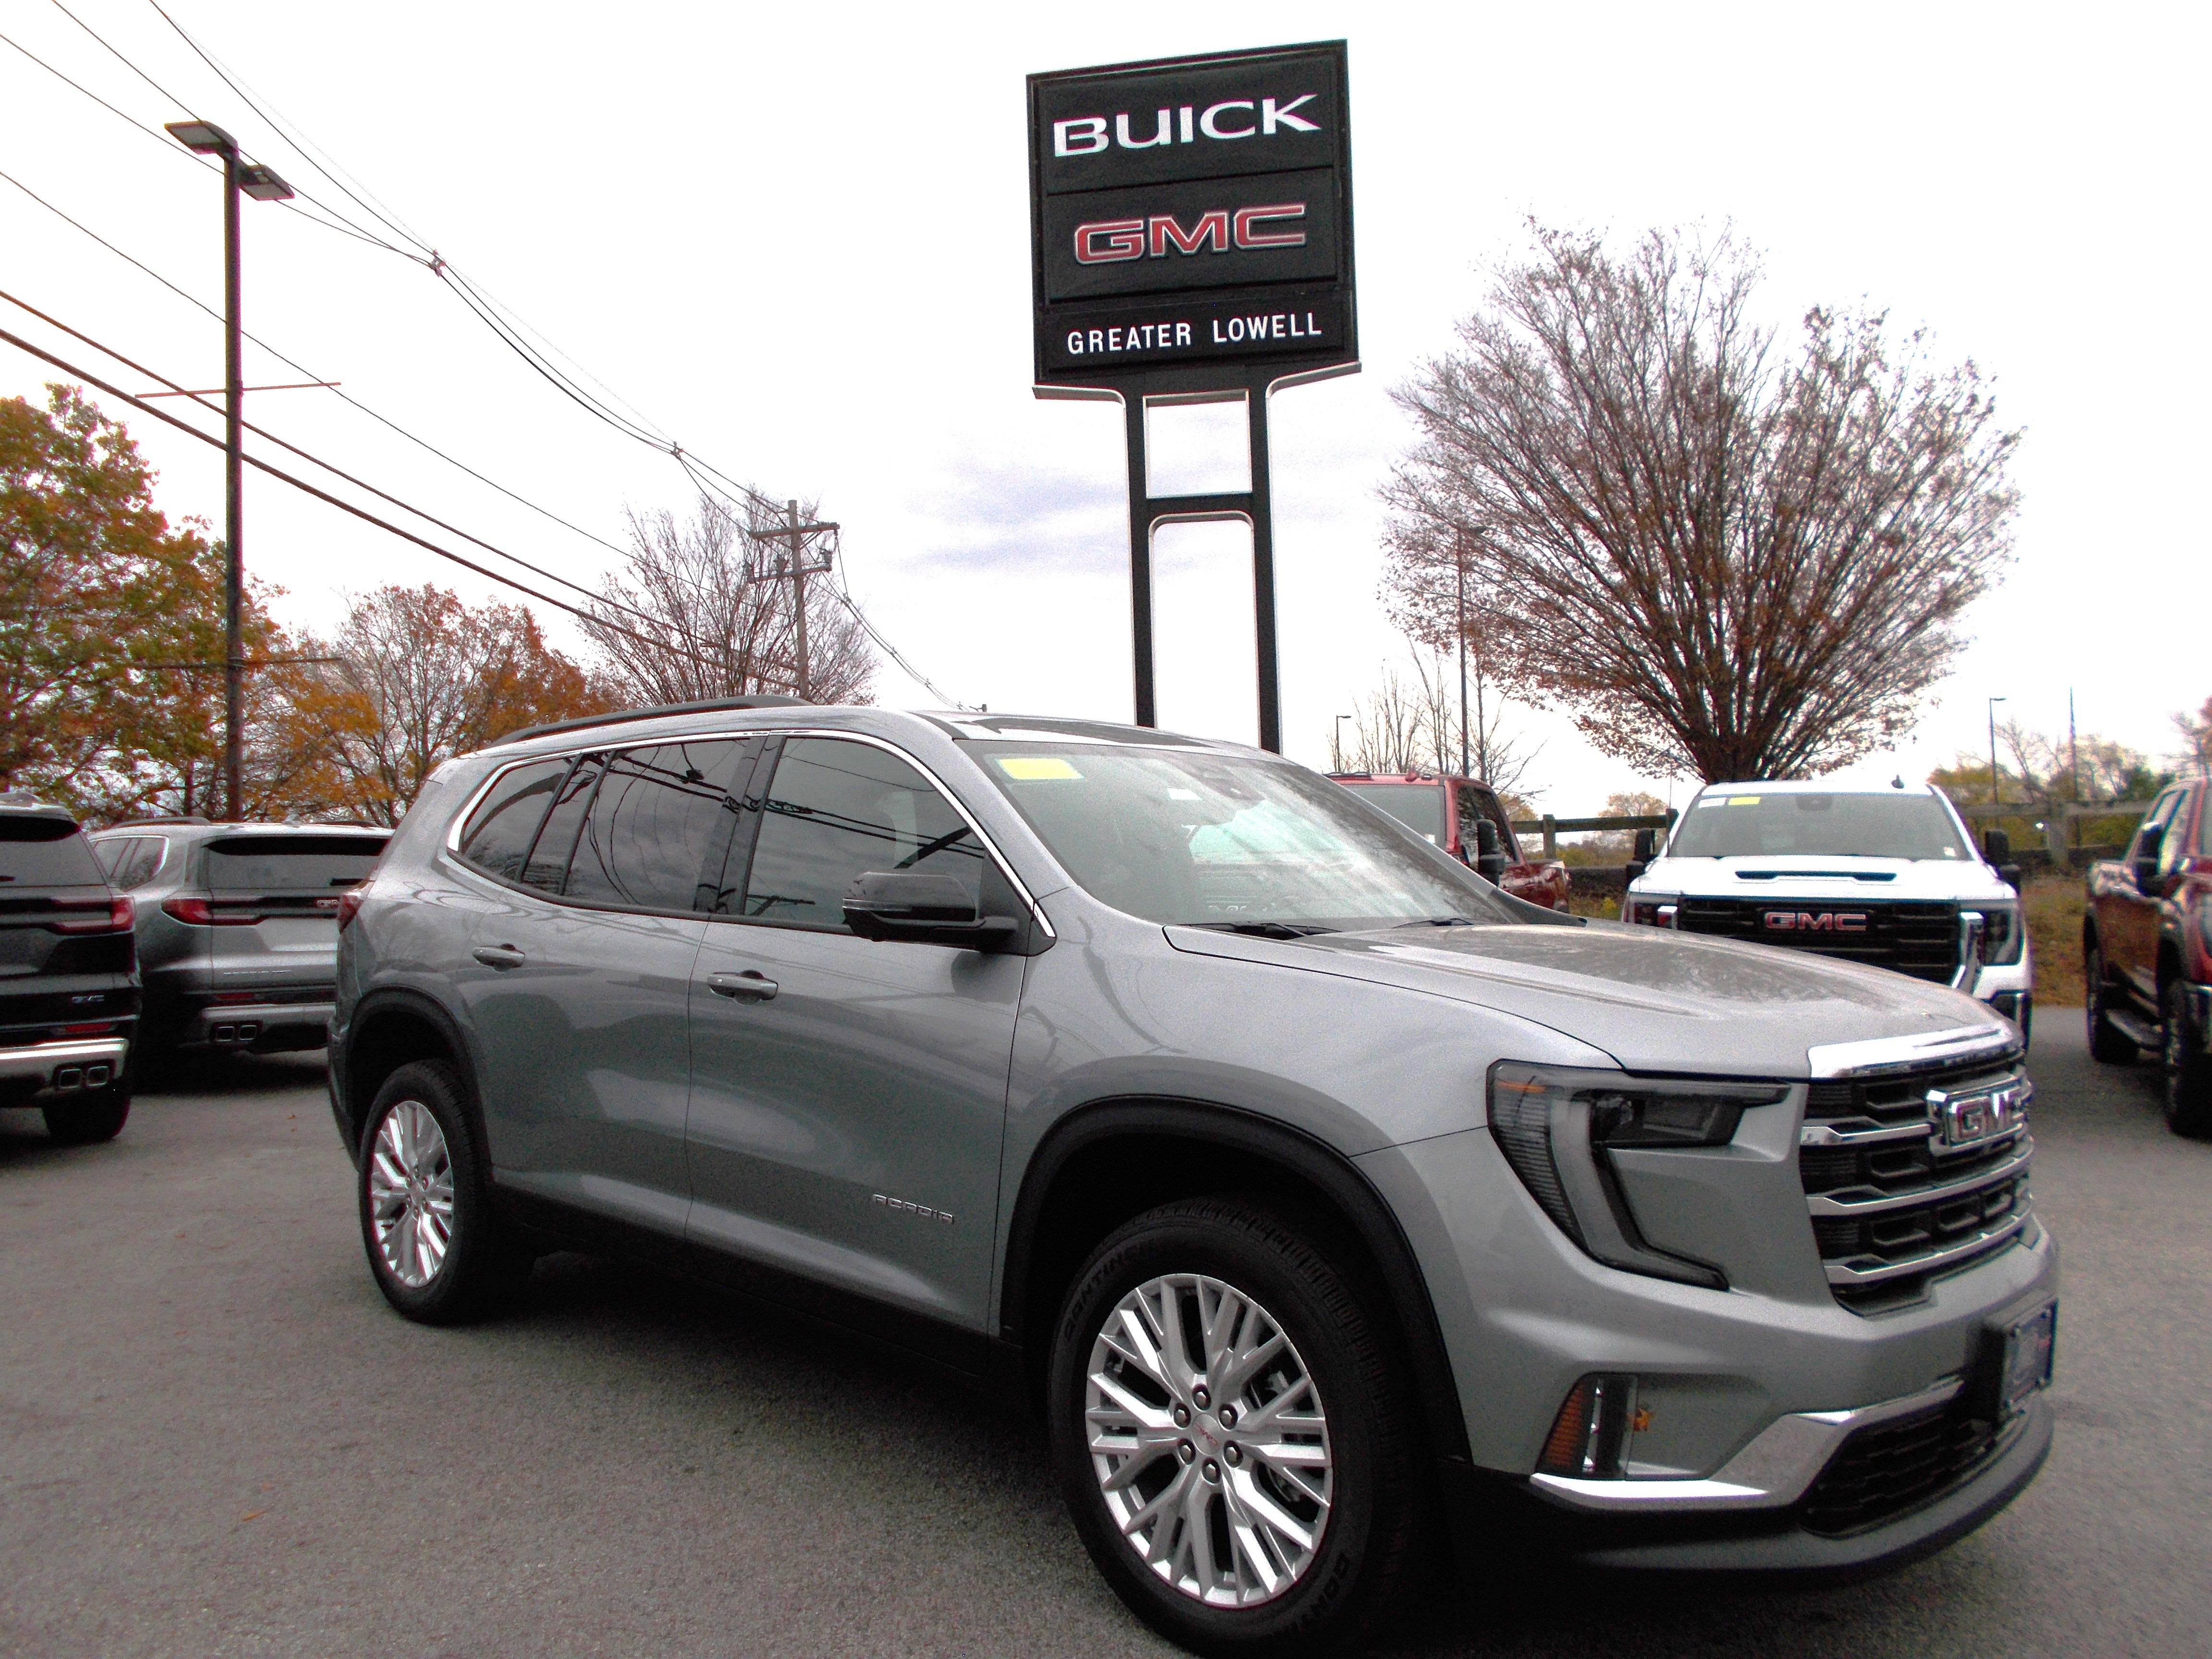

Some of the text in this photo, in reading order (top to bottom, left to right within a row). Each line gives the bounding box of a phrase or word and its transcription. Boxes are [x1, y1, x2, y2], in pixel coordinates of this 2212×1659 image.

[1054, 93, 1322, 157] BUICK
[1074, 202, 1306, 265] GMC
[1067, 312, 1322, 355] GREATER LOWELL
[1765, 912, 1866, 931] GMC
